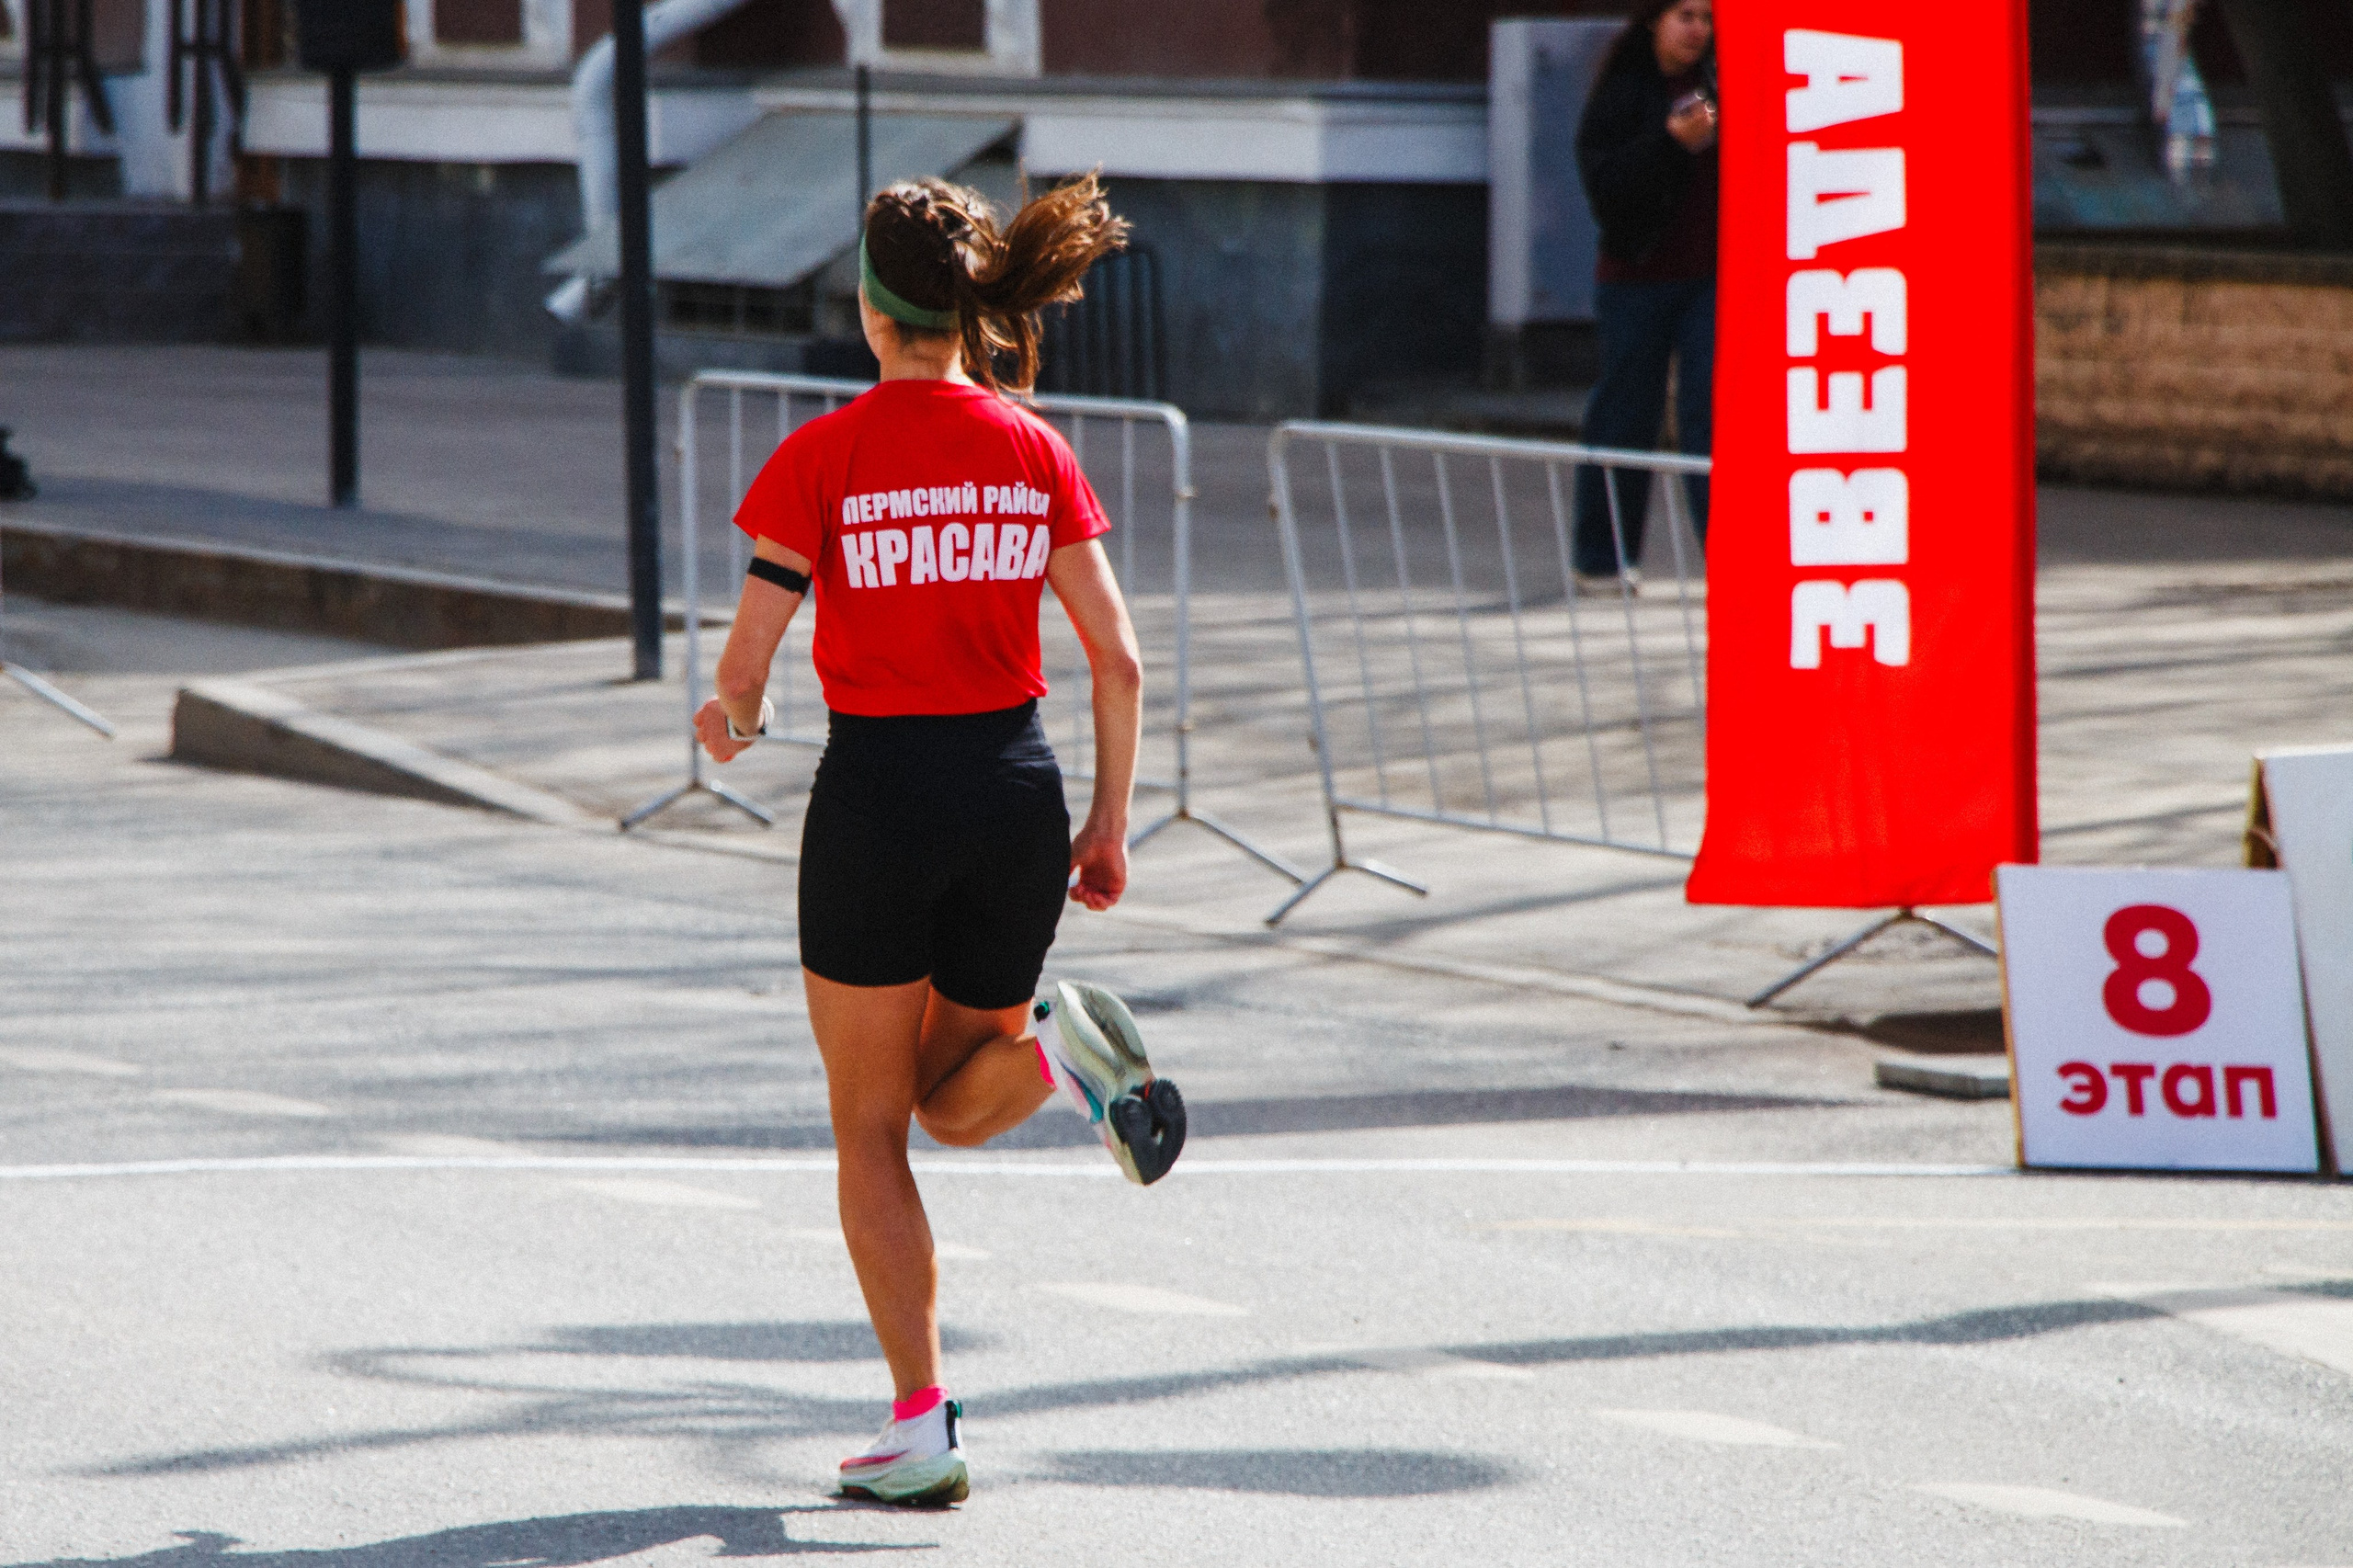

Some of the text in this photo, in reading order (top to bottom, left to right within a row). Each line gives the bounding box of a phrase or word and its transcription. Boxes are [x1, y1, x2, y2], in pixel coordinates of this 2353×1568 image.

[842, 481, 978, 525] ПЕРМСКИЙ
[841, 522, 1051, 588] КРАСАВА
[2102, 903, 2212, 1040] 8
[2056, 1061, 2279, 1119] этап
